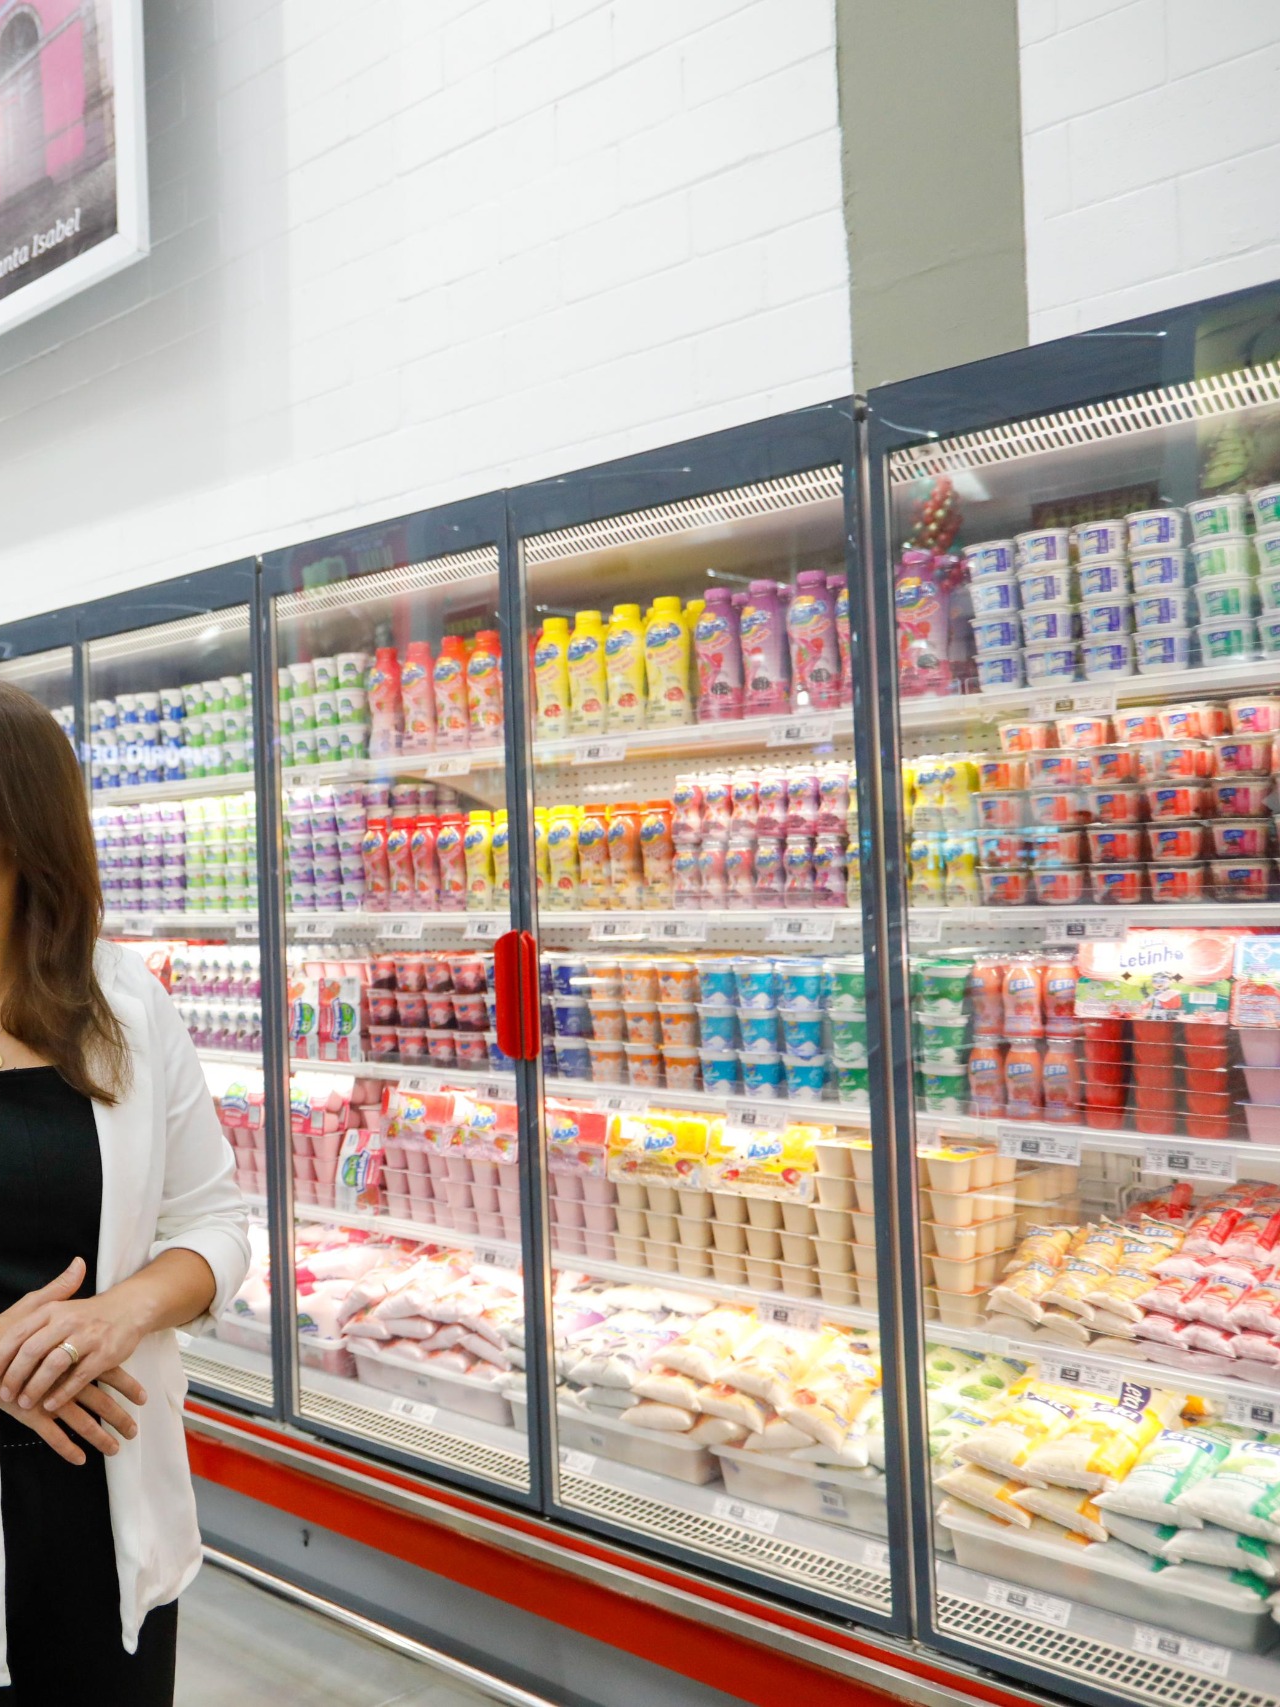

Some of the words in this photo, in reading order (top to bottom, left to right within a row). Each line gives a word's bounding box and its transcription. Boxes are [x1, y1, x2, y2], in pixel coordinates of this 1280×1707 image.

[31, 207, 82, 258] Isabel
[1119, 946, 1184, 968] Letinho
[1009, 978, 1035, 991] LETA
[1049, 978, 1076, 991] LETA
[971, 1060, 997, 1072] LETA
[1008, 1063, 1033, 1075] LETA
[1043, 1065, 1068, 1077] LETA
